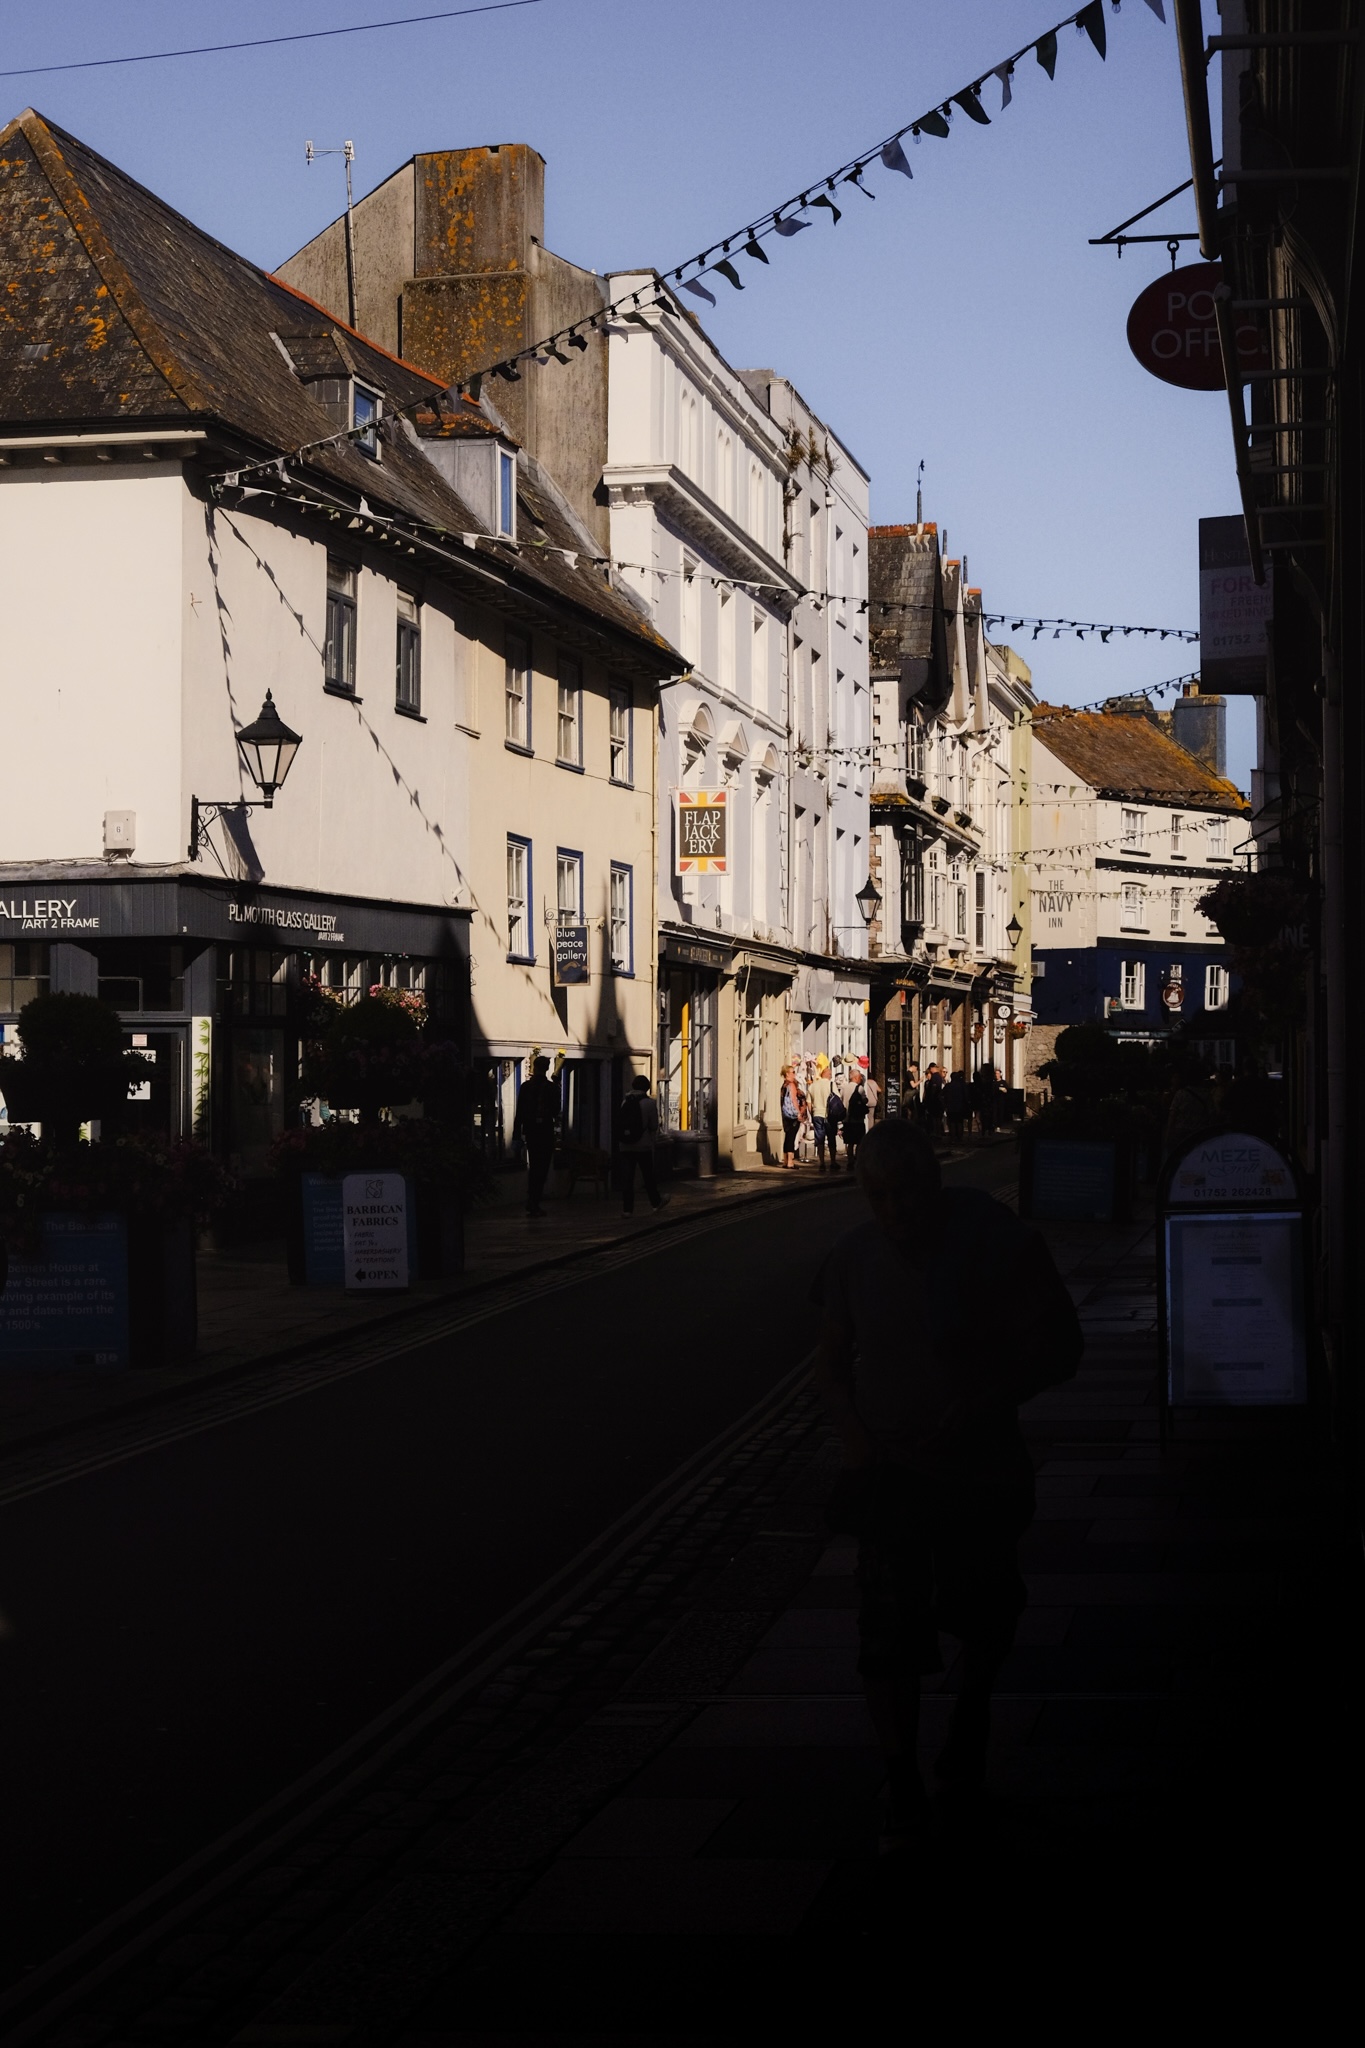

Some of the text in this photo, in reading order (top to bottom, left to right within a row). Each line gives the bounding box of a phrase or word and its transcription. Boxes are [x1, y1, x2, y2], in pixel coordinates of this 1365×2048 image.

[1168, 290, 1216, 322] PO
[1151, 325, 1268, 359] OFFC
[1211, 576, 1253, 595] FOR
[1213, 634, 1251, 646] 01752
[684, 810, 721, 825] FLAP
[684, 824, 721, 842] JACK
[689, 839, 717, 854] ERY
[1048, 880, 1064, 890] THE
[1039, 894, 1073, 912] NAVY
[51, 918, 58, 928] 2
[60, 917, 99, 928] FRAME
[276, 910, 302, 930] GLASS
[302, 913, 337, 932] GALLERY
[1048, 917, 1063, 928] INN
[556, 927, 576, 938] blue
[556, 940, 584, 950] peace
[556, 949, 587, 961] gallery
[1201, 1149, 1260, 1163] MEZE
[1194, 1187, 1272, 1198] 01752 262428
[347, 1204, 404, 1215] BARBICAN
[45, 1220, 65, 1231] The
[352, 1216, 399, 1227] FABRICS
[49, 1262, 86, 1273] House
[88, 1263, 99, 1272] at
[368, 1270, 399, 1280] OPEN
[24, 1277, 58, 1287] Street
[61, 1277, 71, 1287] is
[84, 1278, 108, 1287] rare
[37, 1291, 84, 1303] example
[87, 1290, 99, 1301] of
[101, 1290, 115, 1300] its
[9, 1306, 30, 1316] and
[33, 1305, 64, 1316] dates
[67, 1304, 93, 1315] from
[96, 1304, 114, 1314] the
